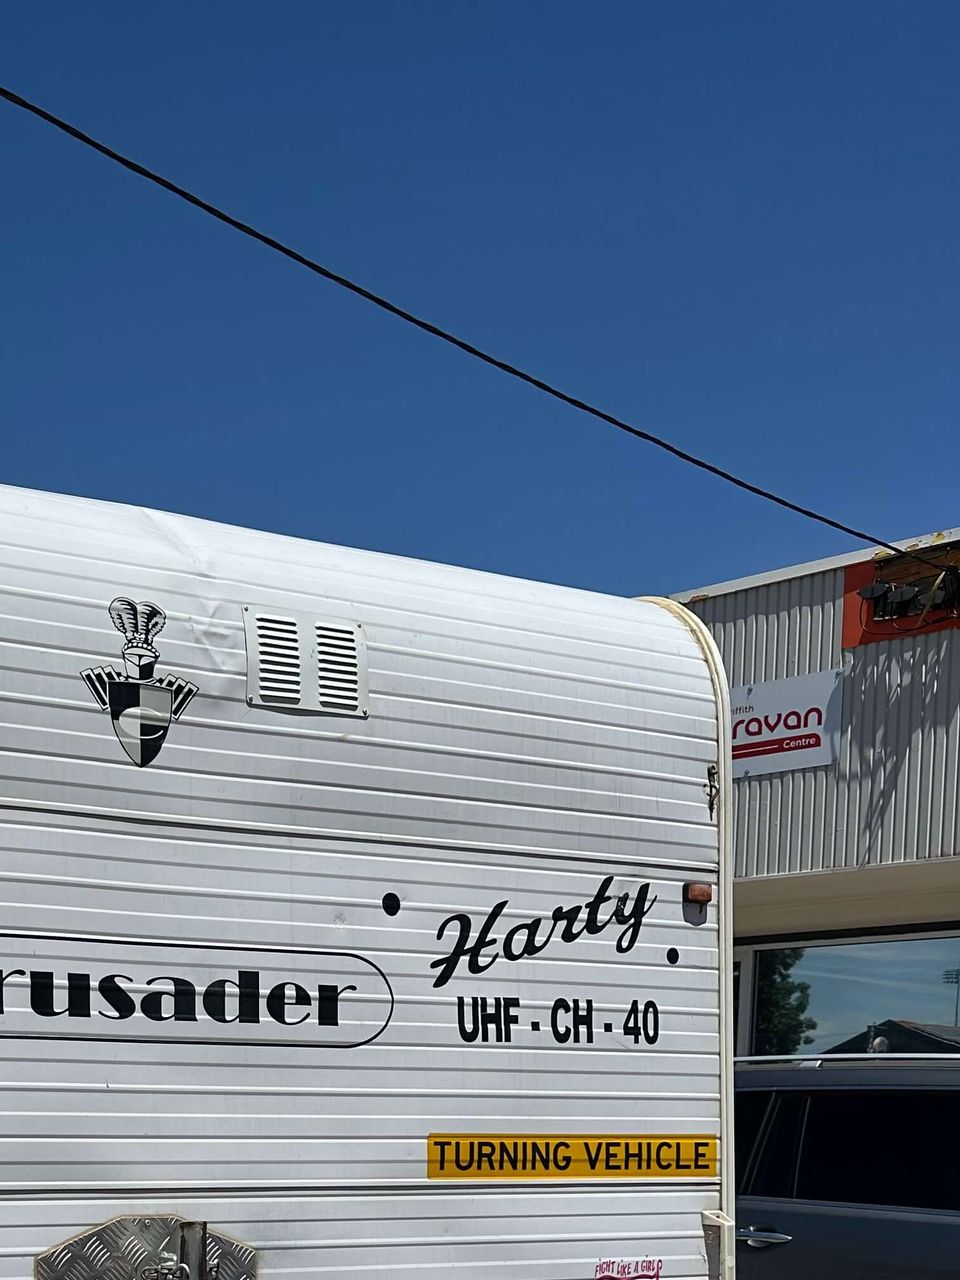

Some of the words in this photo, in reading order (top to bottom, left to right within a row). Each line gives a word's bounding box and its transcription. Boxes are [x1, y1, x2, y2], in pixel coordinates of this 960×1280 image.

[731, 705, 754, 715] iffith
[783, 737, 816, 748] Centre
[430, 875, 658, 988] Harty
[457, 996, 520, 1043] UHF
[551, 997, 593, 1044] CH
[623, 1000, 659, 1045] 40
[433, 1141, 572, 1171] TURNING
[583, 1141, 710, 1170] VEHICLE
